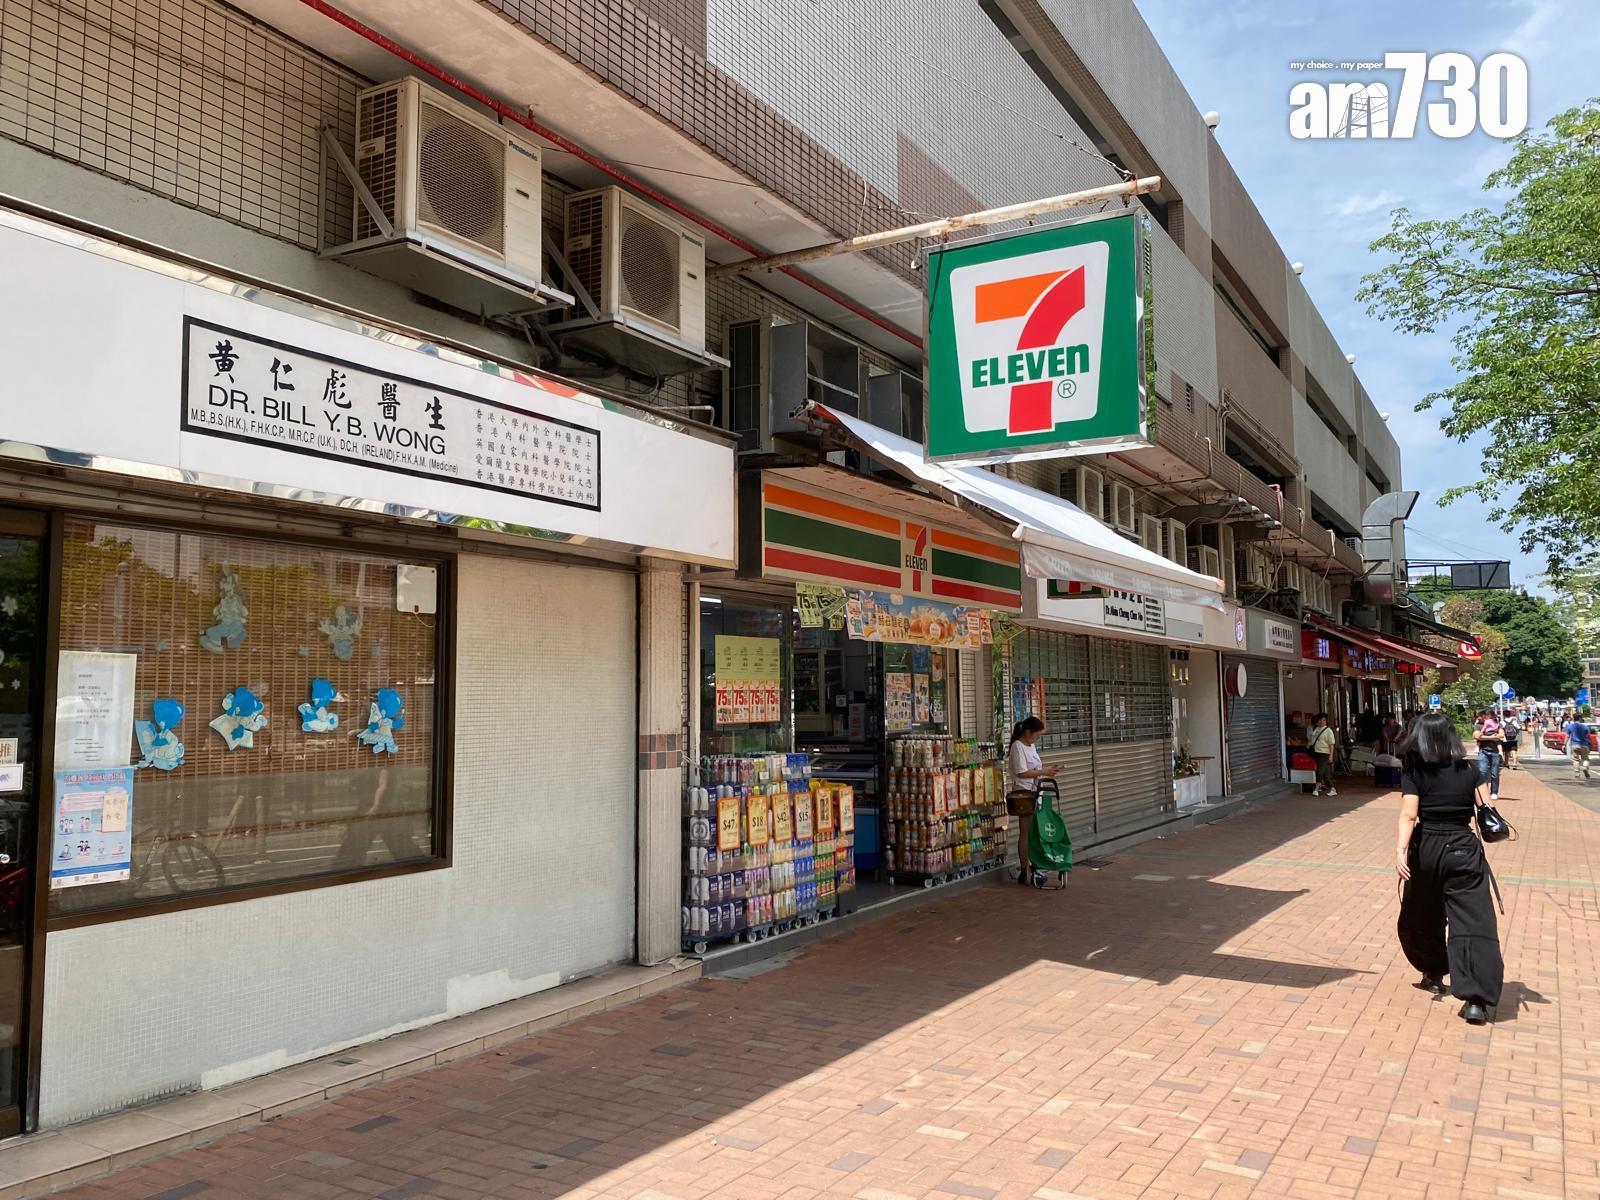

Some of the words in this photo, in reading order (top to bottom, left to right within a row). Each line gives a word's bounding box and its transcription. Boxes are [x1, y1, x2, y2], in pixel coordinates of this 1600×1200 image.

[508, 139, 538, 162] Panasonic
[974, 264, 1086, 434] 7
[208, 384, 255, 415] DR.
[263, 396, 316, 428] BILL
[373, 421, 446, 456] WONG
[428, 458, 459, 475] (Medicine)
[1431, 696, 1439, 704] P
[722, 818, 735, 831] $47
[752, 816, 764, 828] $18
